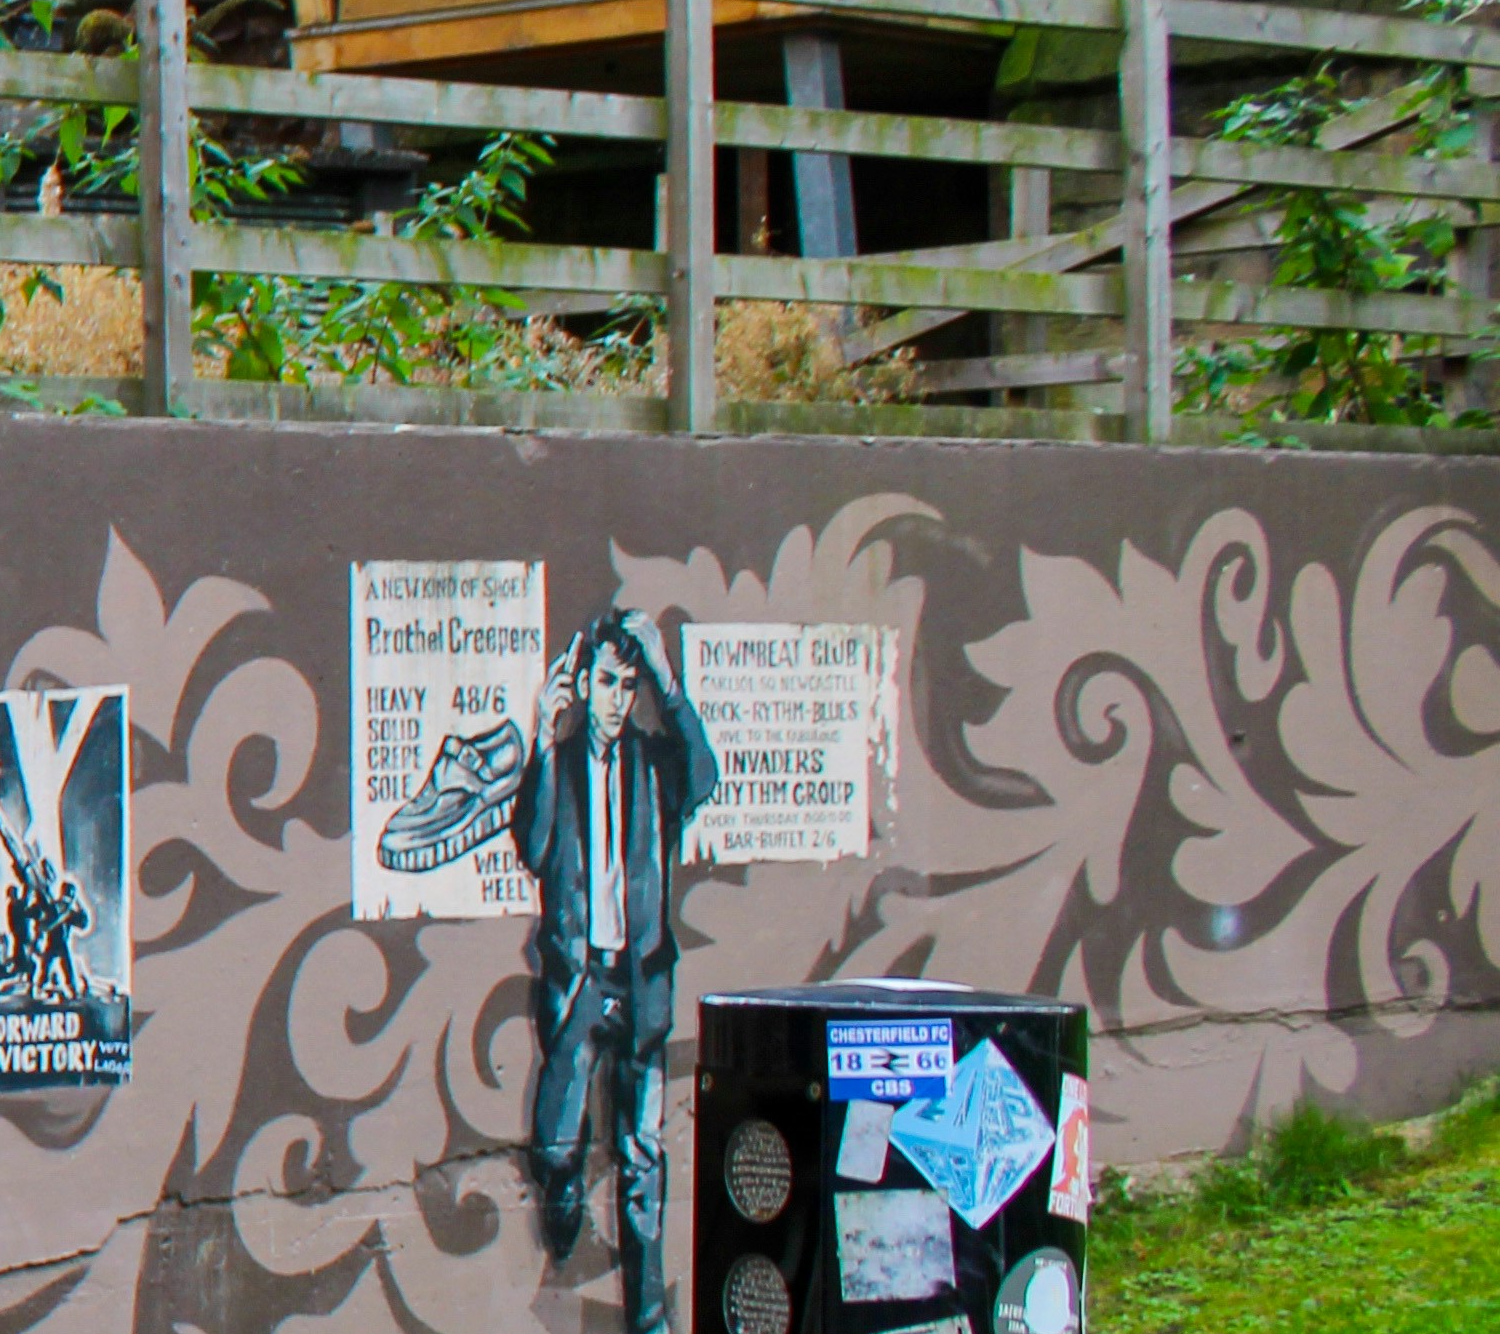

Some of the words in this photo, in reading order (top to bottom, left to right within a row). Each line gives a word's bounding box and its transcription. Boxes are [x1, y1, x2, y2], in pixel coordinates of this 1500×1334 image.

[365, 579, 378, 600] A
[382, 577, 419, 599] NEW
[422, 576, 457, 599] KIND
[460, 578, 479, 599] OF
[366, 617, 444, 655] Brothel
[448, 617, 542, 657] Creepers
[699, 638, 800, 667] DOWNBEAT
[779, 674, 856, 692] NEWCASTLE
[366, 685, 426, 713] HEAVY
[451, 685, 508, 714] 48/6
[367, 717, 420, 742] SOLID
[367, 744, 422, 770] CREPE
[724, 748, 825, 775] INVADERS
[367, 774, 412, 802] SOLE
[792, 780, 855, 806] GROUP
[481, 876, 528, 902] HEEL
[830, 1026, 929, 1044] CHESTERFIELD
[931, 1025, 949, 1042] FC
[831, 1052, 862, 1071] 18
[917, 1051, 946, 1070] 66
[871, 1078, 914, 1097] CBS
